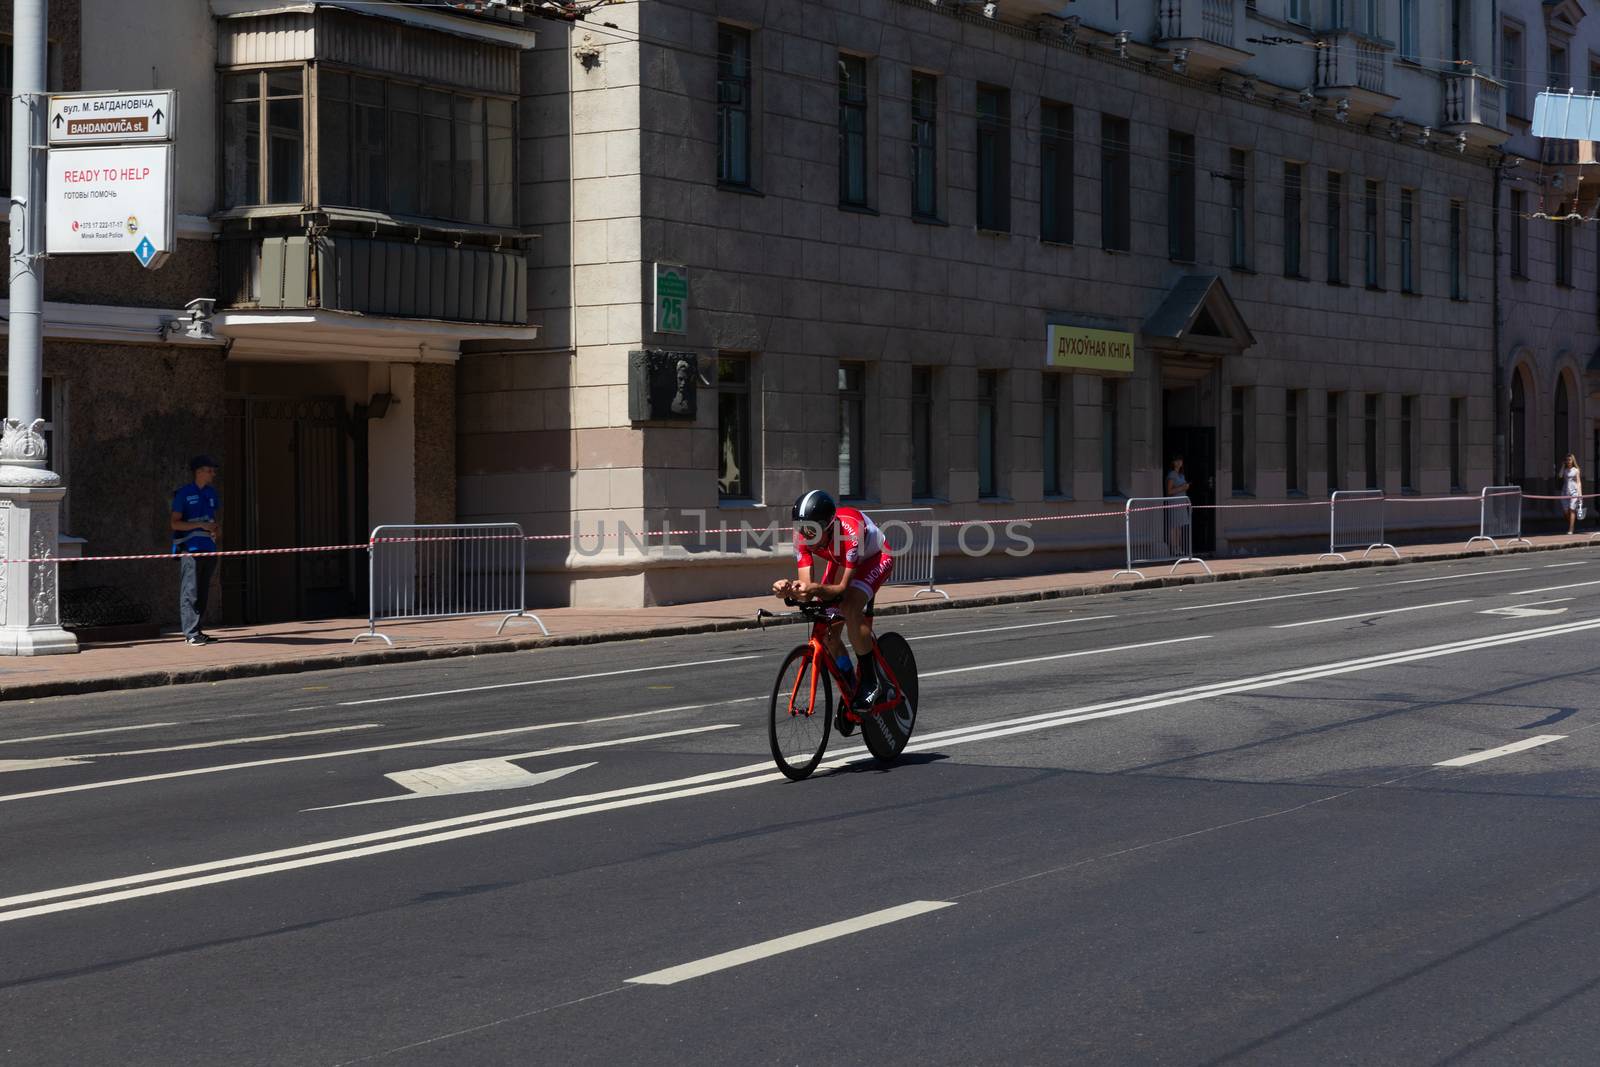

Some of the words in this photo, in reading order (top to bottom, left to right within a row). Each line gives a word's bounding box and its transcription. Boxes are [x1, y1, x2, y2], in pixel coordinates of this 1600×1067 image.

[63, 105, 80, 115] вул.
[82, 102, 91, 111] М.
[93, 99, 154, 112] БАГДАНОВІЧА
[134, 121, 144, 132] st.
[64, 169, 101, 183] READY
[103, 168, 118, 182] TO
[120, 167, 150, 181] HELP
[662, 297, 683, 330] 25
[1058, 335, 1106, 357] ДУХОЎНАЯ
[1108, 342, 1131, 359] КНІГА
